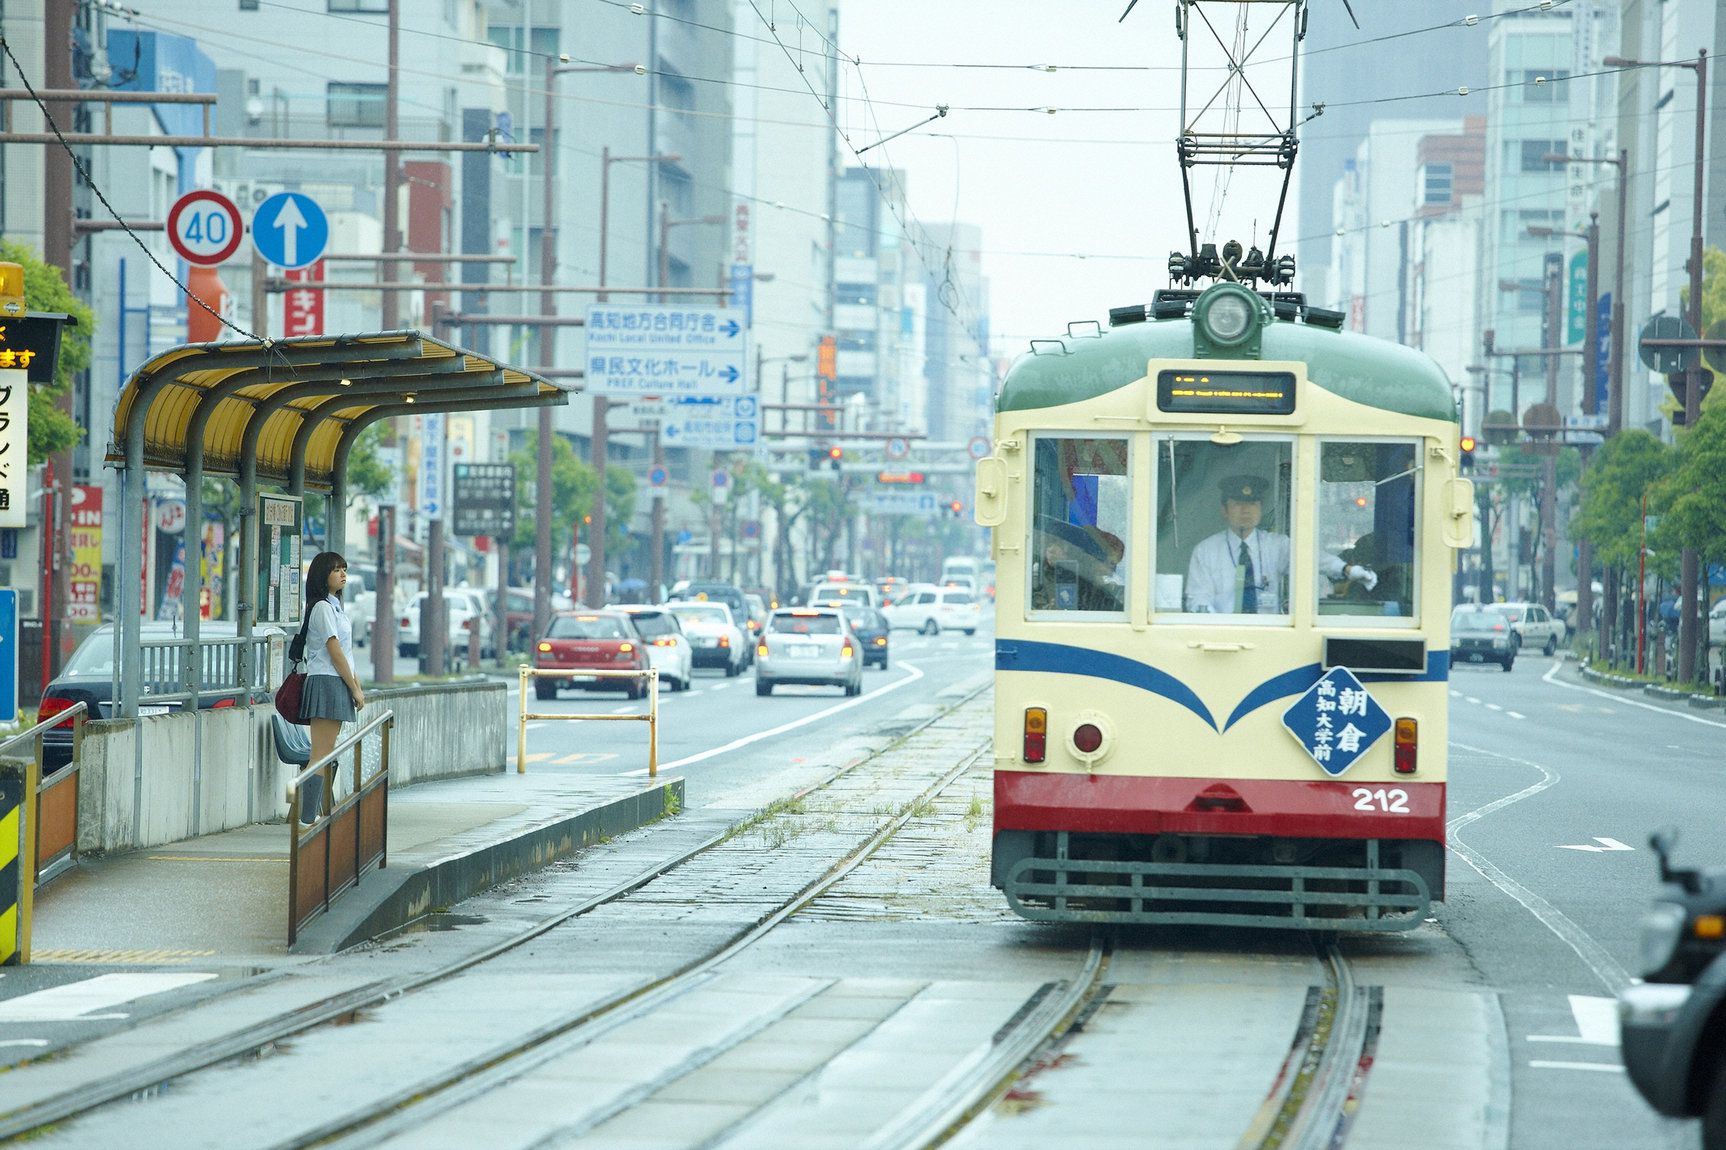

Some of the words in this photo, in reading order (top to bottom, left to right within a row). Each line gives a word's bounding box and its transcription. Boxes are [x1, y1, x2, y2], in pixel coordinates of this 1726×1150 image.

[185, 211, 226, 244] 40
[591, 311, 716, 332] 高知地方合同庁舎
[0, 348, 36, 368] ます
[591, 356, 716, 377] 県民文化ホール
[1313, 680, 1337, 761] 高知大学前
[1336, 688, 1368, 753] 朝倉
[1352, 788, 1411, 814] 212
